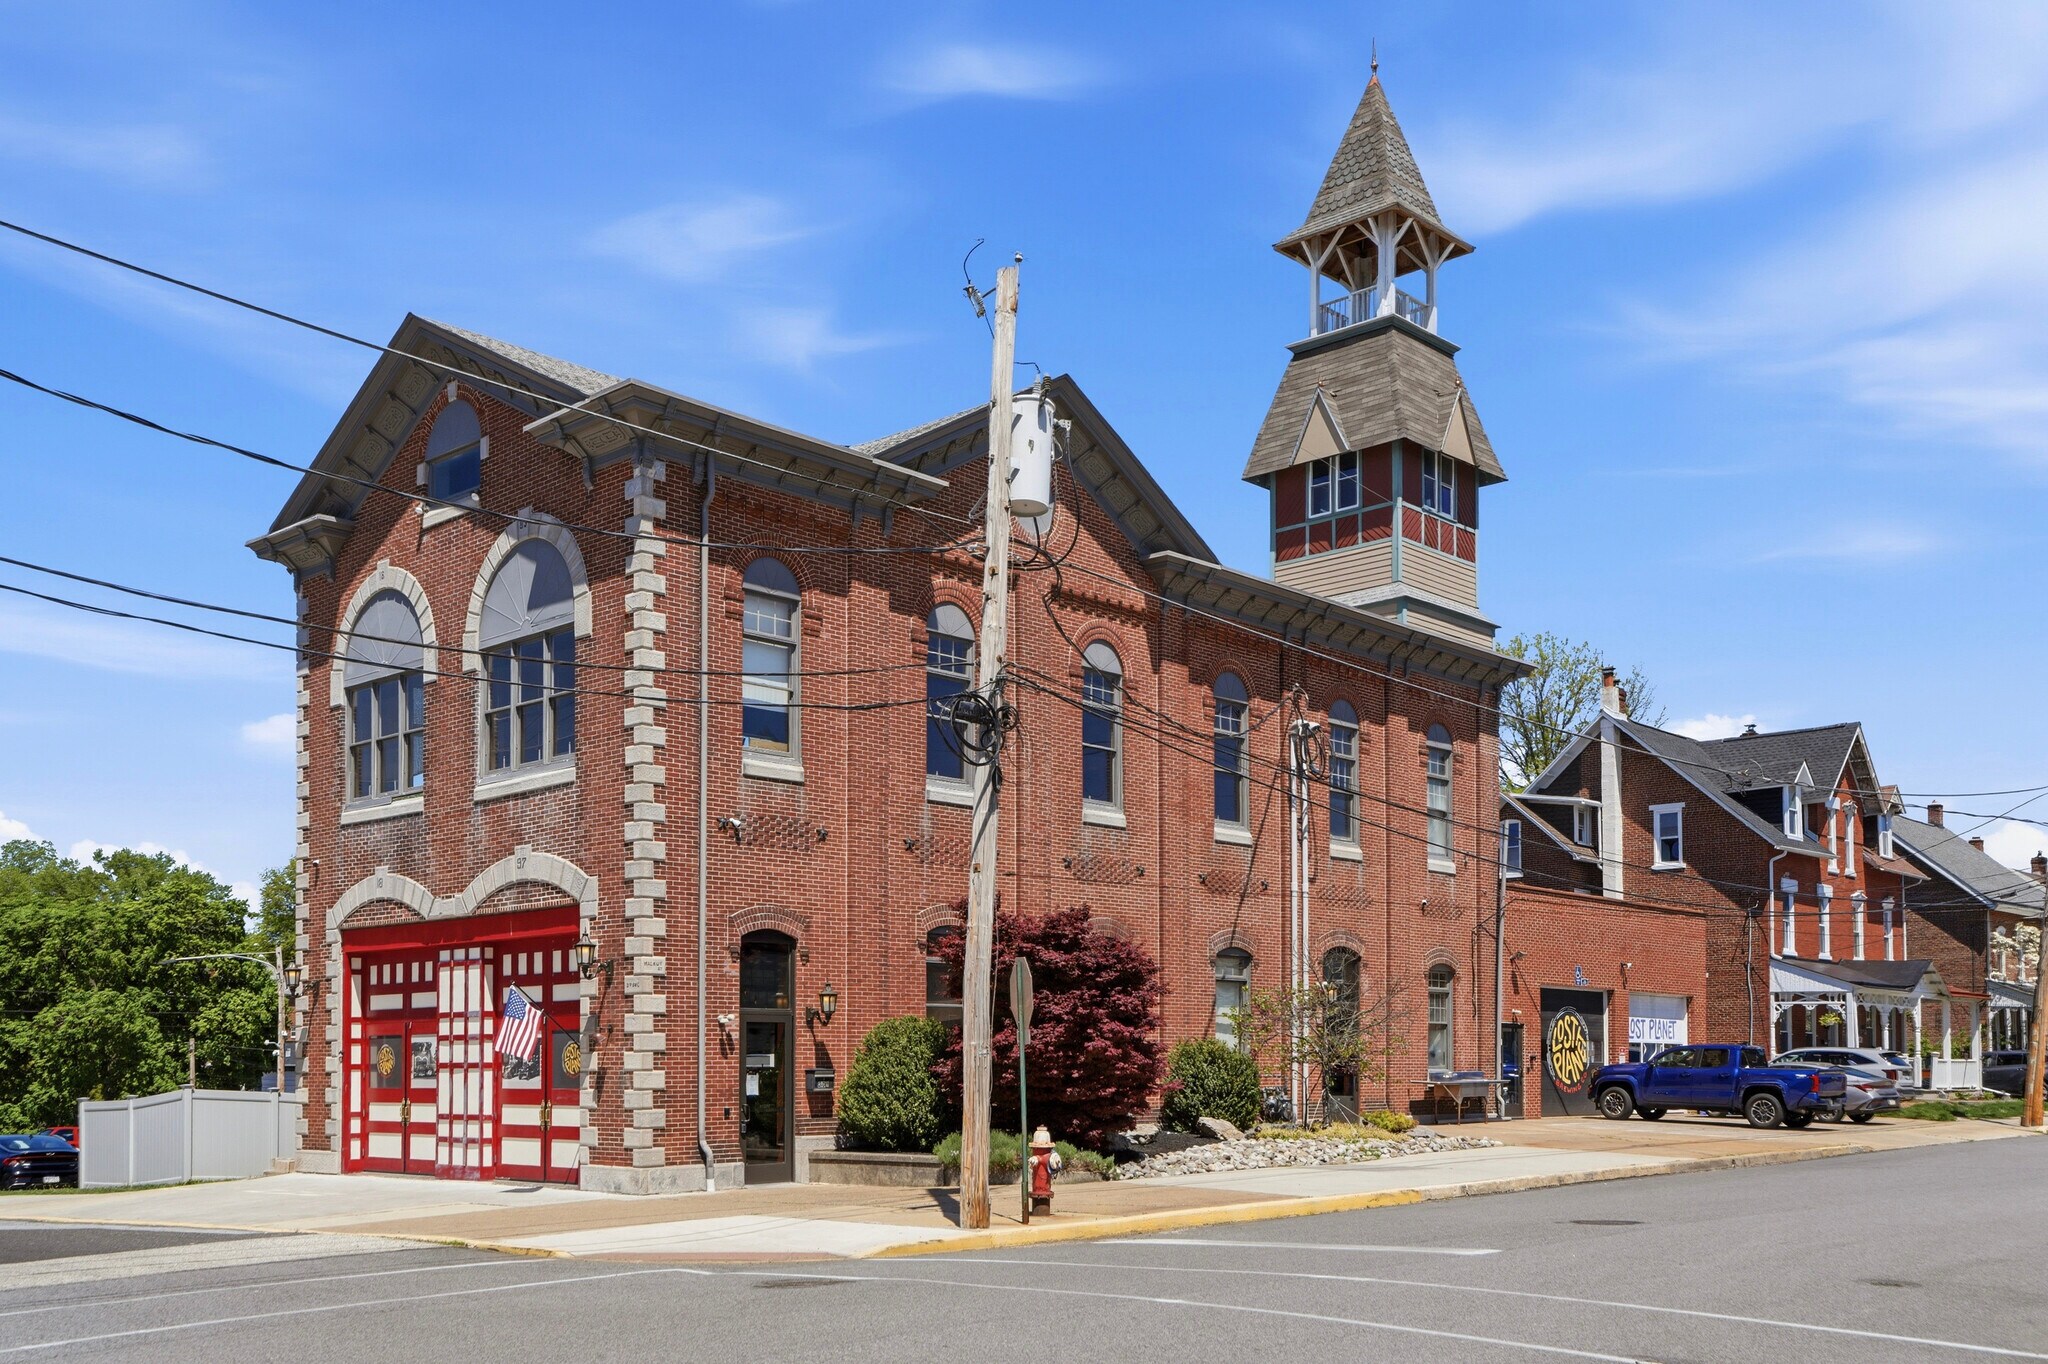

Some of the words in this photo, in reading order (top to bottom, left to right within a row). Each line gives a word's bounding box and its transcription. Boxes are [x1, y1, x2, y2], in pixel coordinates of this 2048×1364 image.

[517, 857, 527, 869] 97
[1552, 1015, 1579, 1053] LOST
[1649, 1019, 1677, 1040] PLANET
